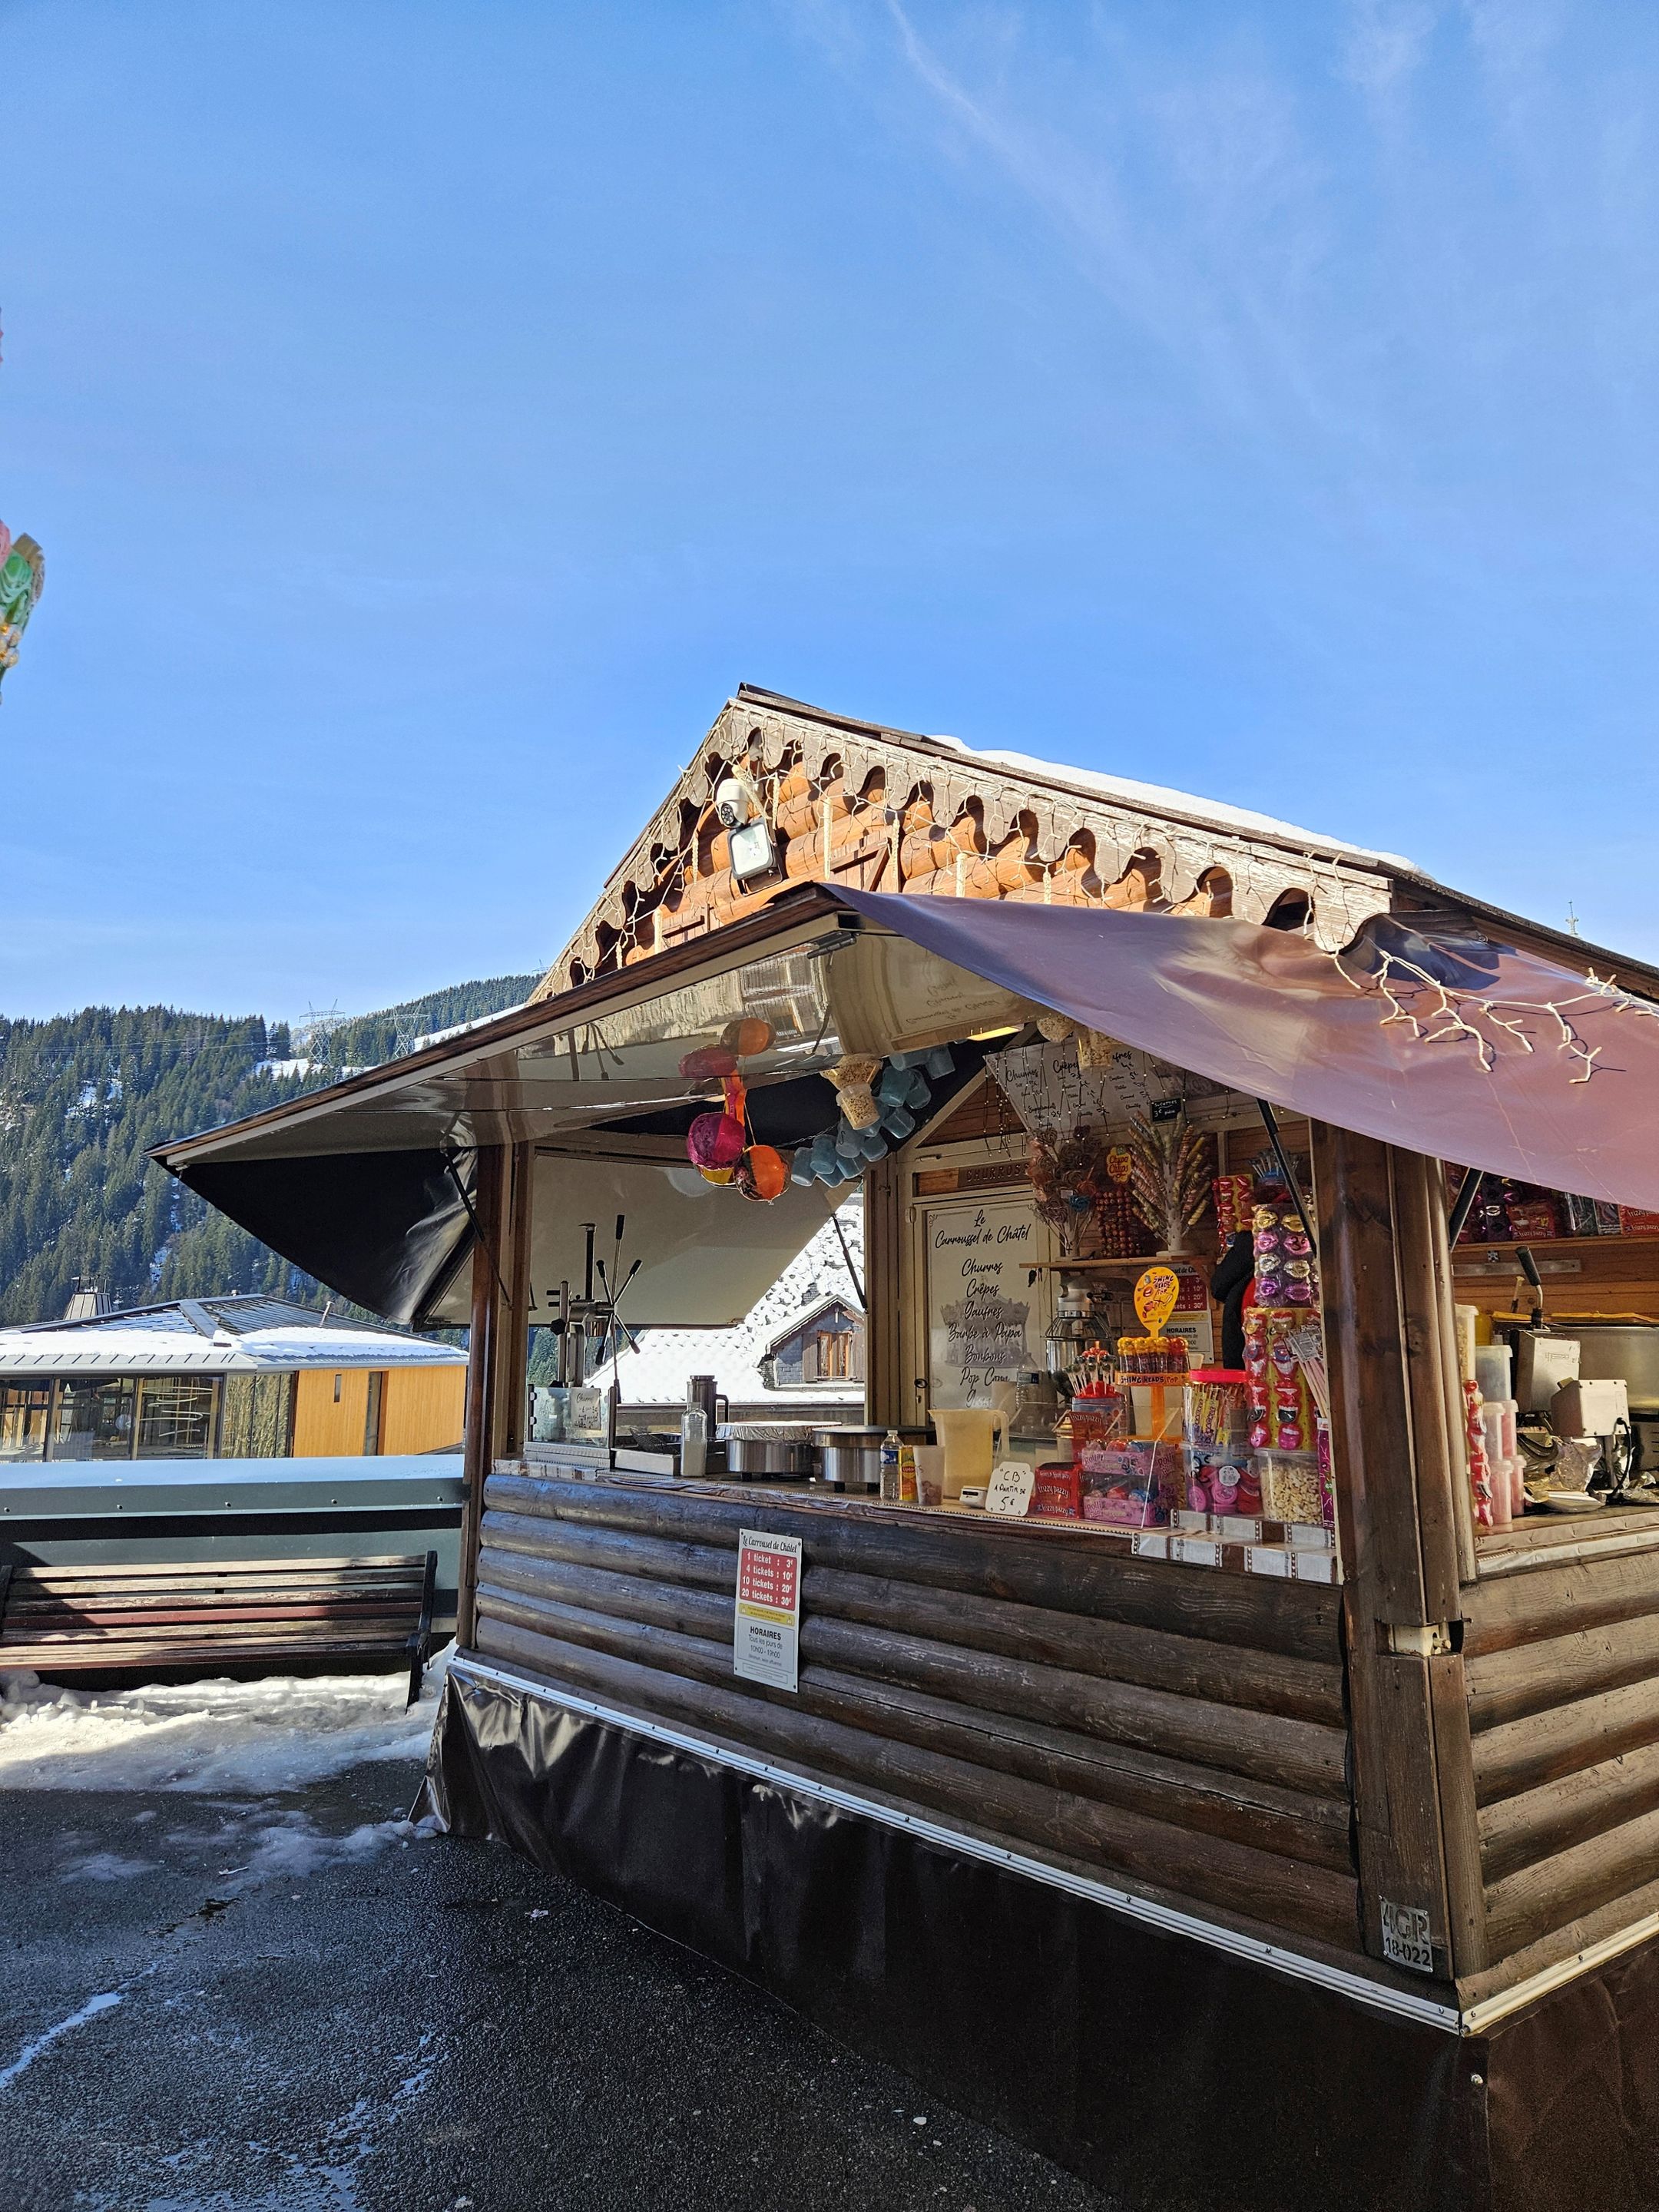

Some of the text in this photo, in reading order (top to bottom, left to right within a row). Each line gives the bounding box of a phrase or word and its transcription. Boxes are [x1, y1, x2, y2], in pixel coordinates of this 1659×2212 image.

[974, 1209, 986, 1227] Le
[935, 1224, 1031, 1249] Carroussel de Châtel
[962, 1258, 1003, 1277] Churros
[967, 1278, 999, 1301] Crêpes
[964, 1300, 1003, 1320] Gaufres
[948, 1321, 1022, 1345] Barbe à Papa
[965, 1344, 1006, 1365] Bonbons
[960, 1366, 980, 1389] Pop
[1038, 1483, 1068, 1498] frizzy pazzy
[743, 1535, 747, 1547] Le
[748, 1536, 772, 1548] Carrousel
[773, 1541, 780, 1550] de
[753, 1553, 771, 1564] ticket
[786, 1559, 793, 1568] 3€
[746, 1564, 750, 1572] 4
[753, 1565, 774, 1578] tickets
[783, 1571, 793, 1581] 10€
[743, 1575, 750, 1584] 10
[753, 1578, 773, 1590] tickets
[781, 1584, 793, 1594] 20€
[741, 1588, 750, 1597] 20
[752, 1590, 773, 1602] tickets
[780, 1597, 792, 1606] 30€
[750, 1626, 781, 1641] HORAIRES
[1386, 1936, 1431, 1967] 18-022
